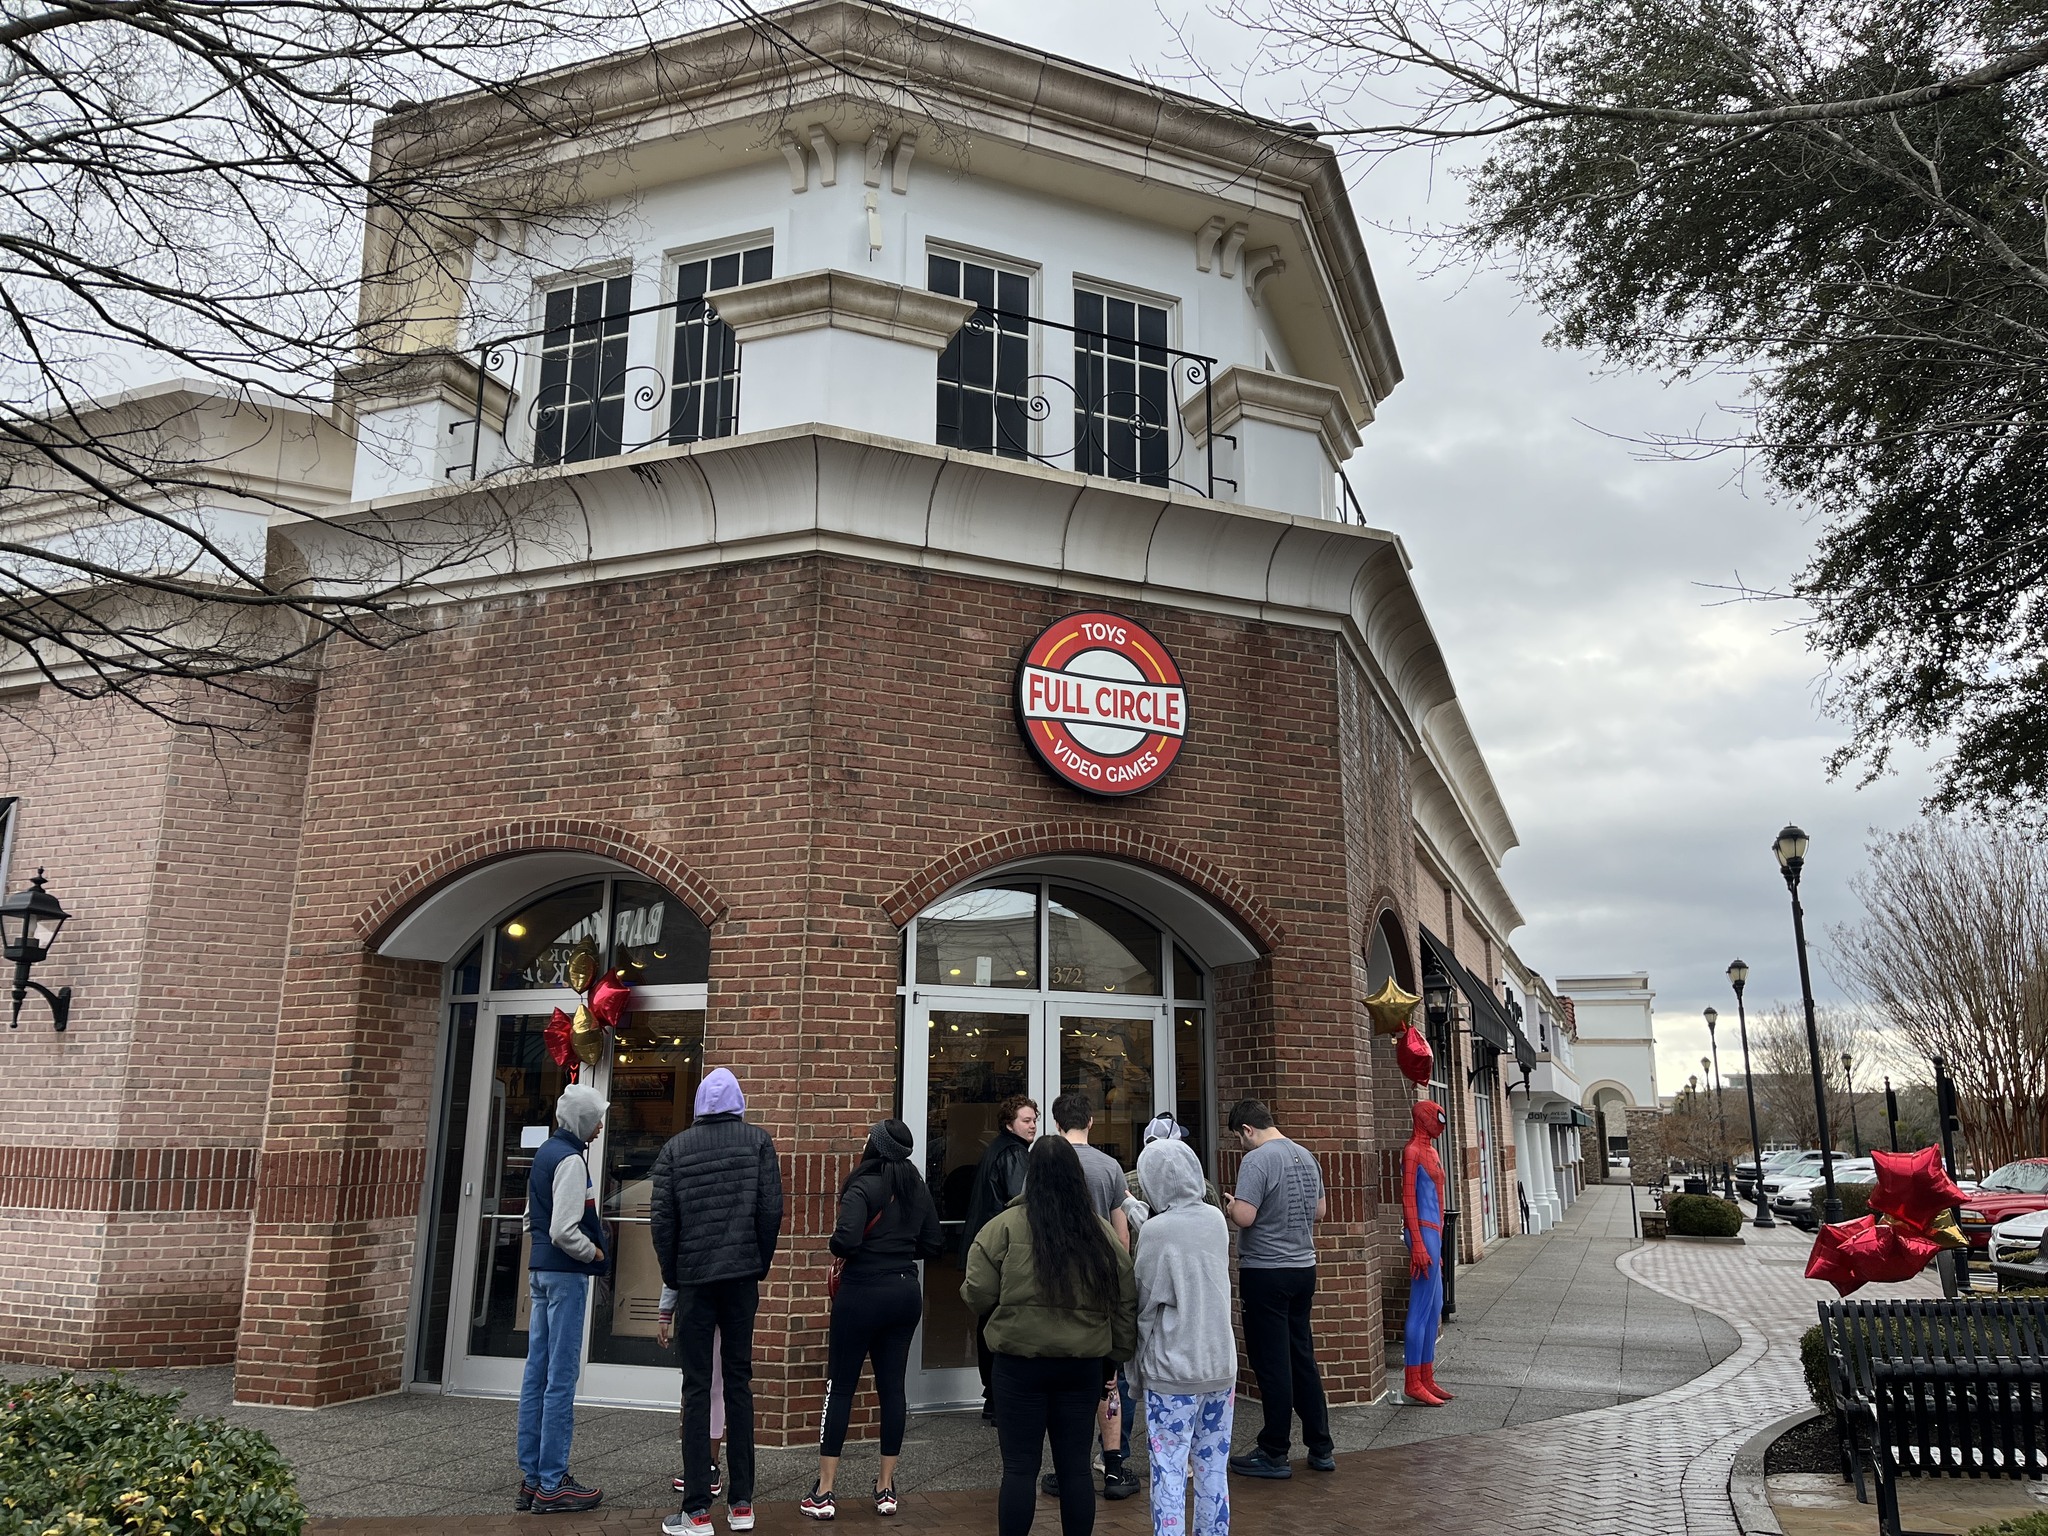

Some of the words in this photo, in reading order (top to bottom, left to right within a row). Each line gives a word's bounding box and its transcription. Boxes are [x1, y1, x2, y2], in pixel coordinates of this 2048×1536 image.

[1081, 623, 1127, 645] TOYS
[1029, 673, 1090, 715] FULL
[1095, 687, 1180, 730] CIRCLE
[1053, 739, 1102, 780] VIDEO
[1106, 751, 1159, 783] GAMES
[1052, 966, 1082, 984] 372
